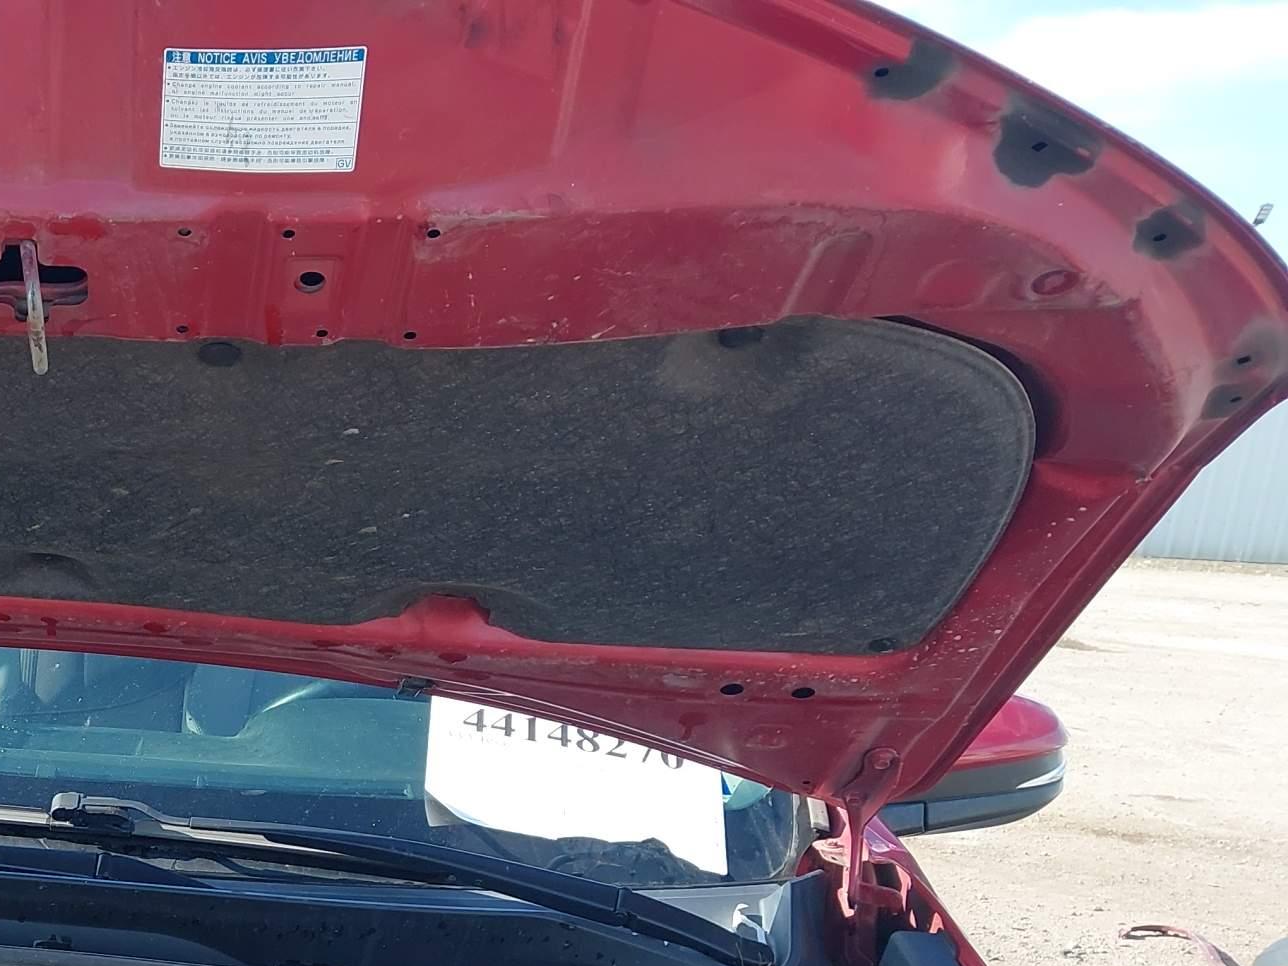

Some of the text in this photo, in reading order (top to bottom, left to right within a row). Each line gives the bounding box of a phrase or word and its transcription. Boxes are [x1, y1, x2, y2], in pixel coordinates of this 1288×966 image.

[197, 52, 237, 64] NOTICE
[242, 52, 268, 64] AVIS
[274, 49, 359, 64] УВЕДОМЛЕНИЕ
[337, 160, 351, 168] GV
